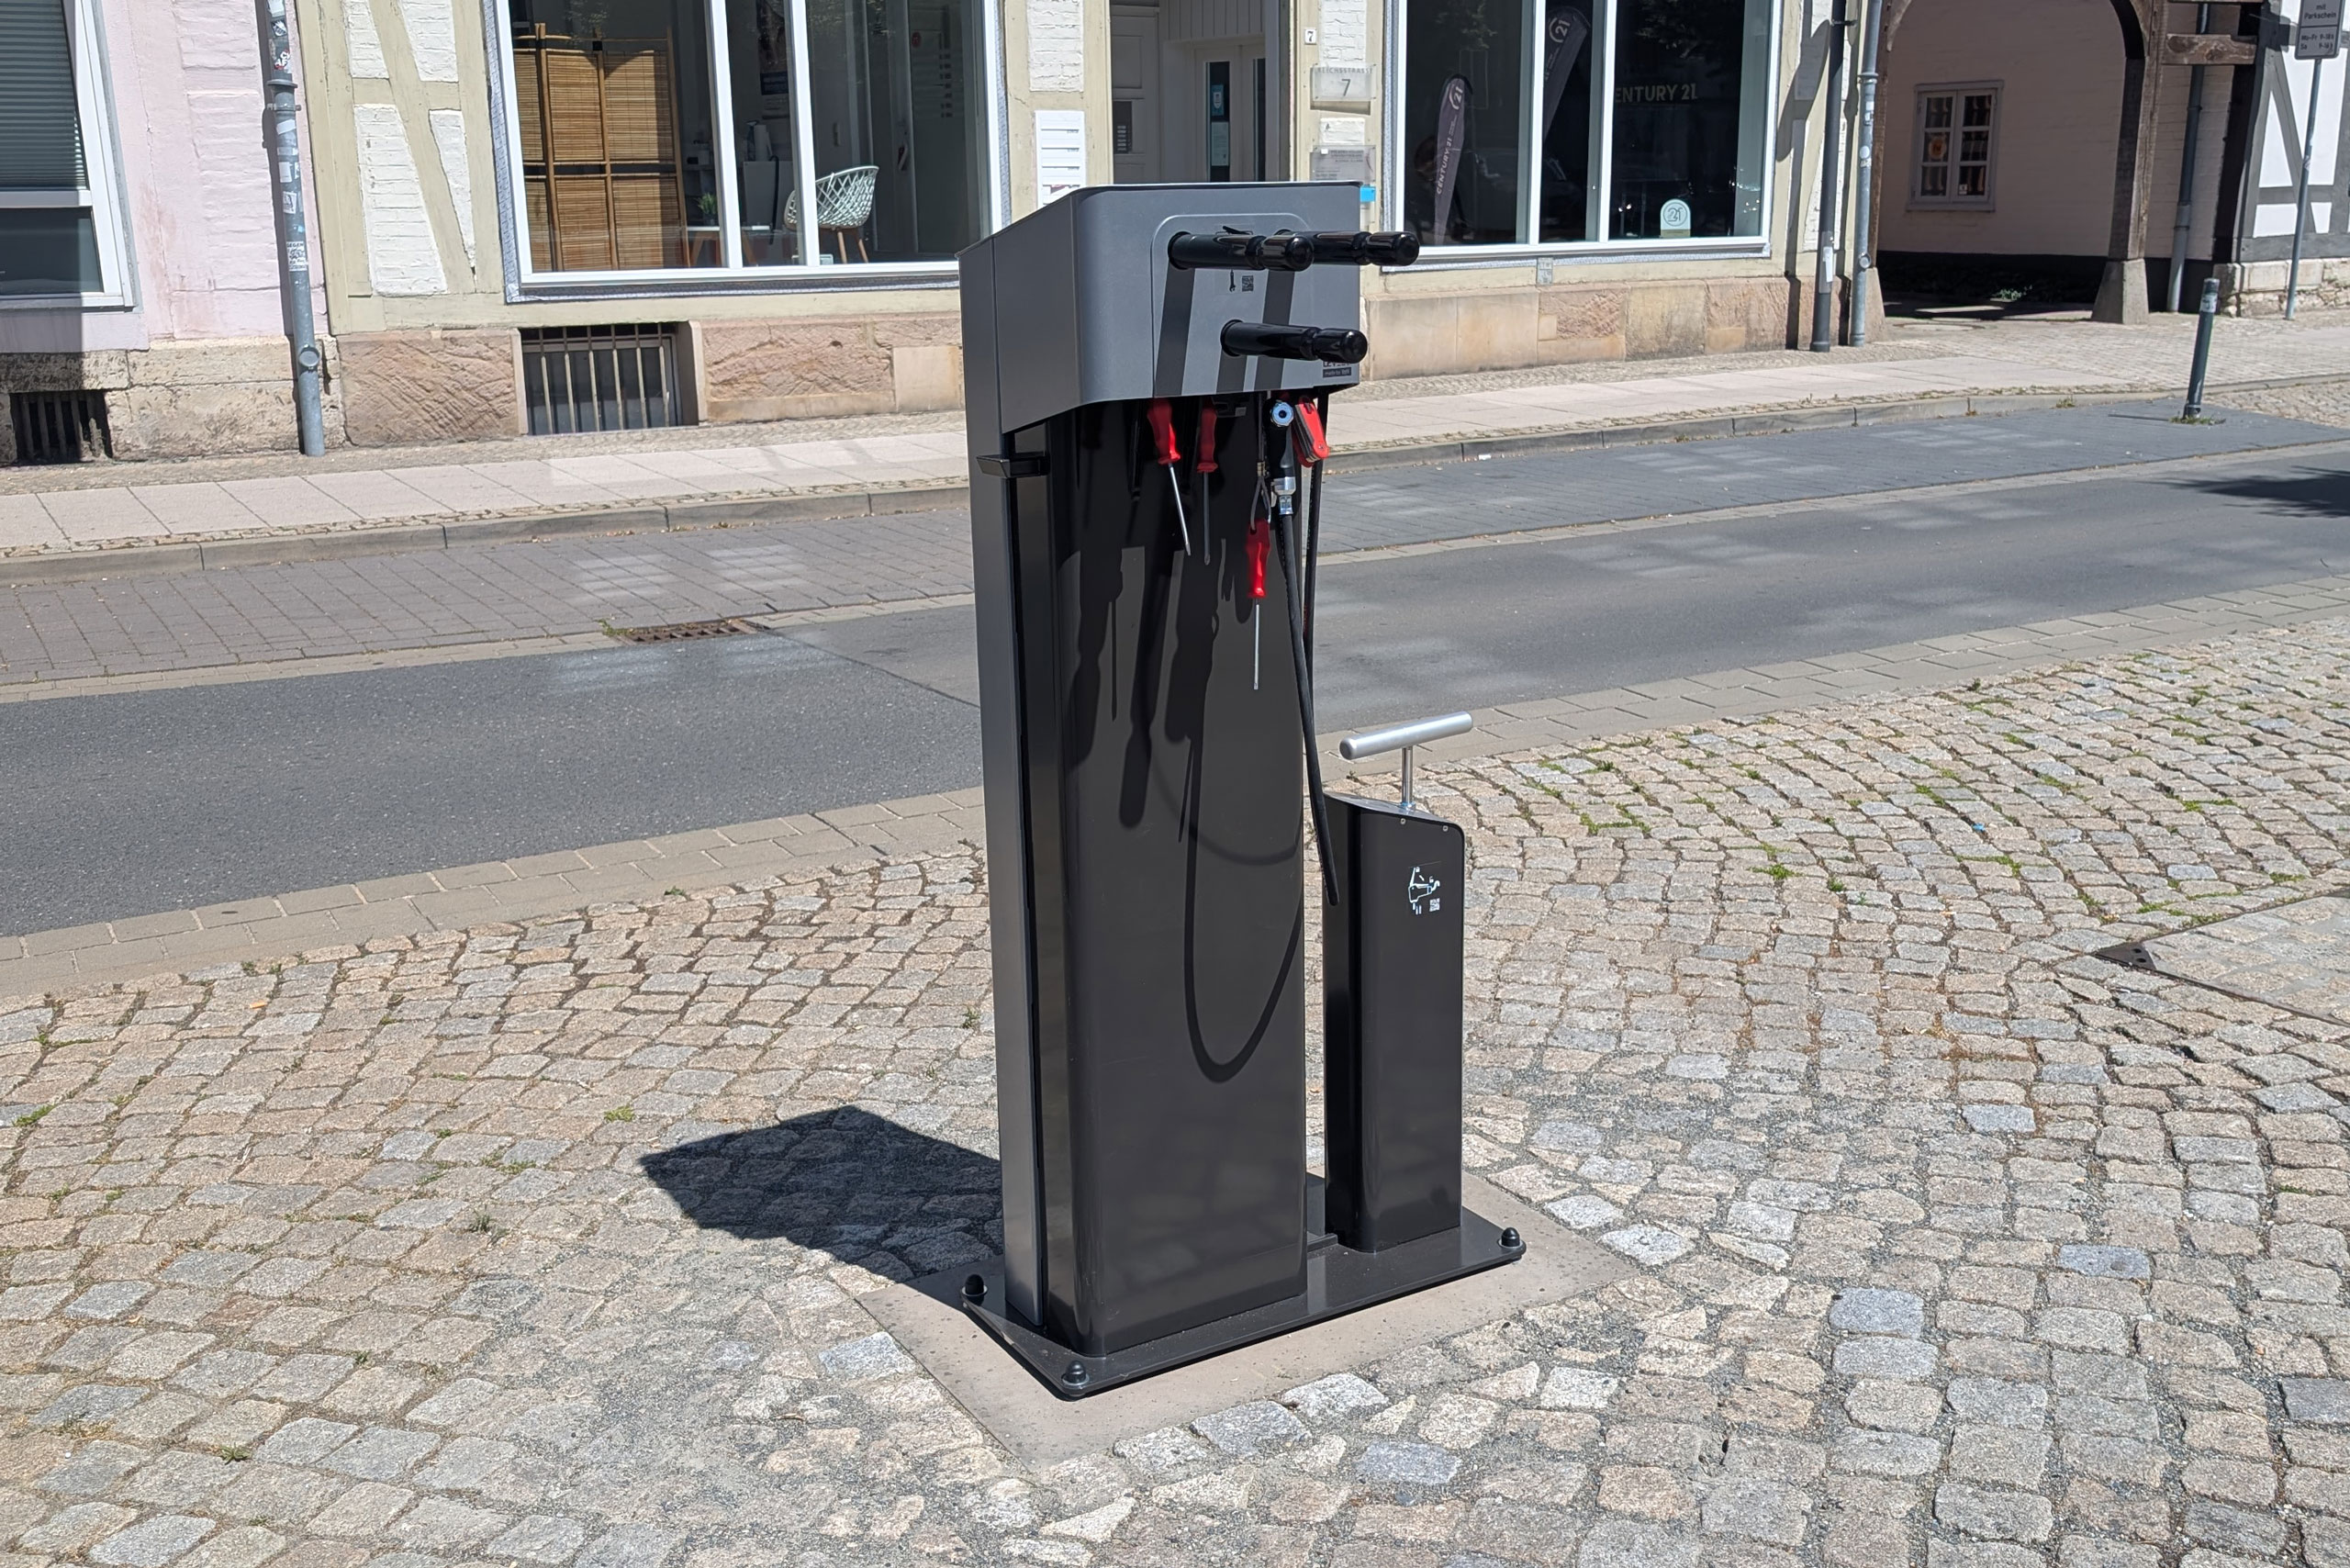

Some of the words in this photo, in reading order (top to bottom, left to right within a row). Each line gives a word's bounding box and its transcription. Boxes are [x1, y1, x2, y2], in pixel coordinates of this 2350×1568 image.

[1307, 30, 1315, 42] 7
[1341, 78, 1351, 96] 7
[1615, 84, 1679, 104] ENTURY
[1436, 147, 1451, 195] CENTURY
